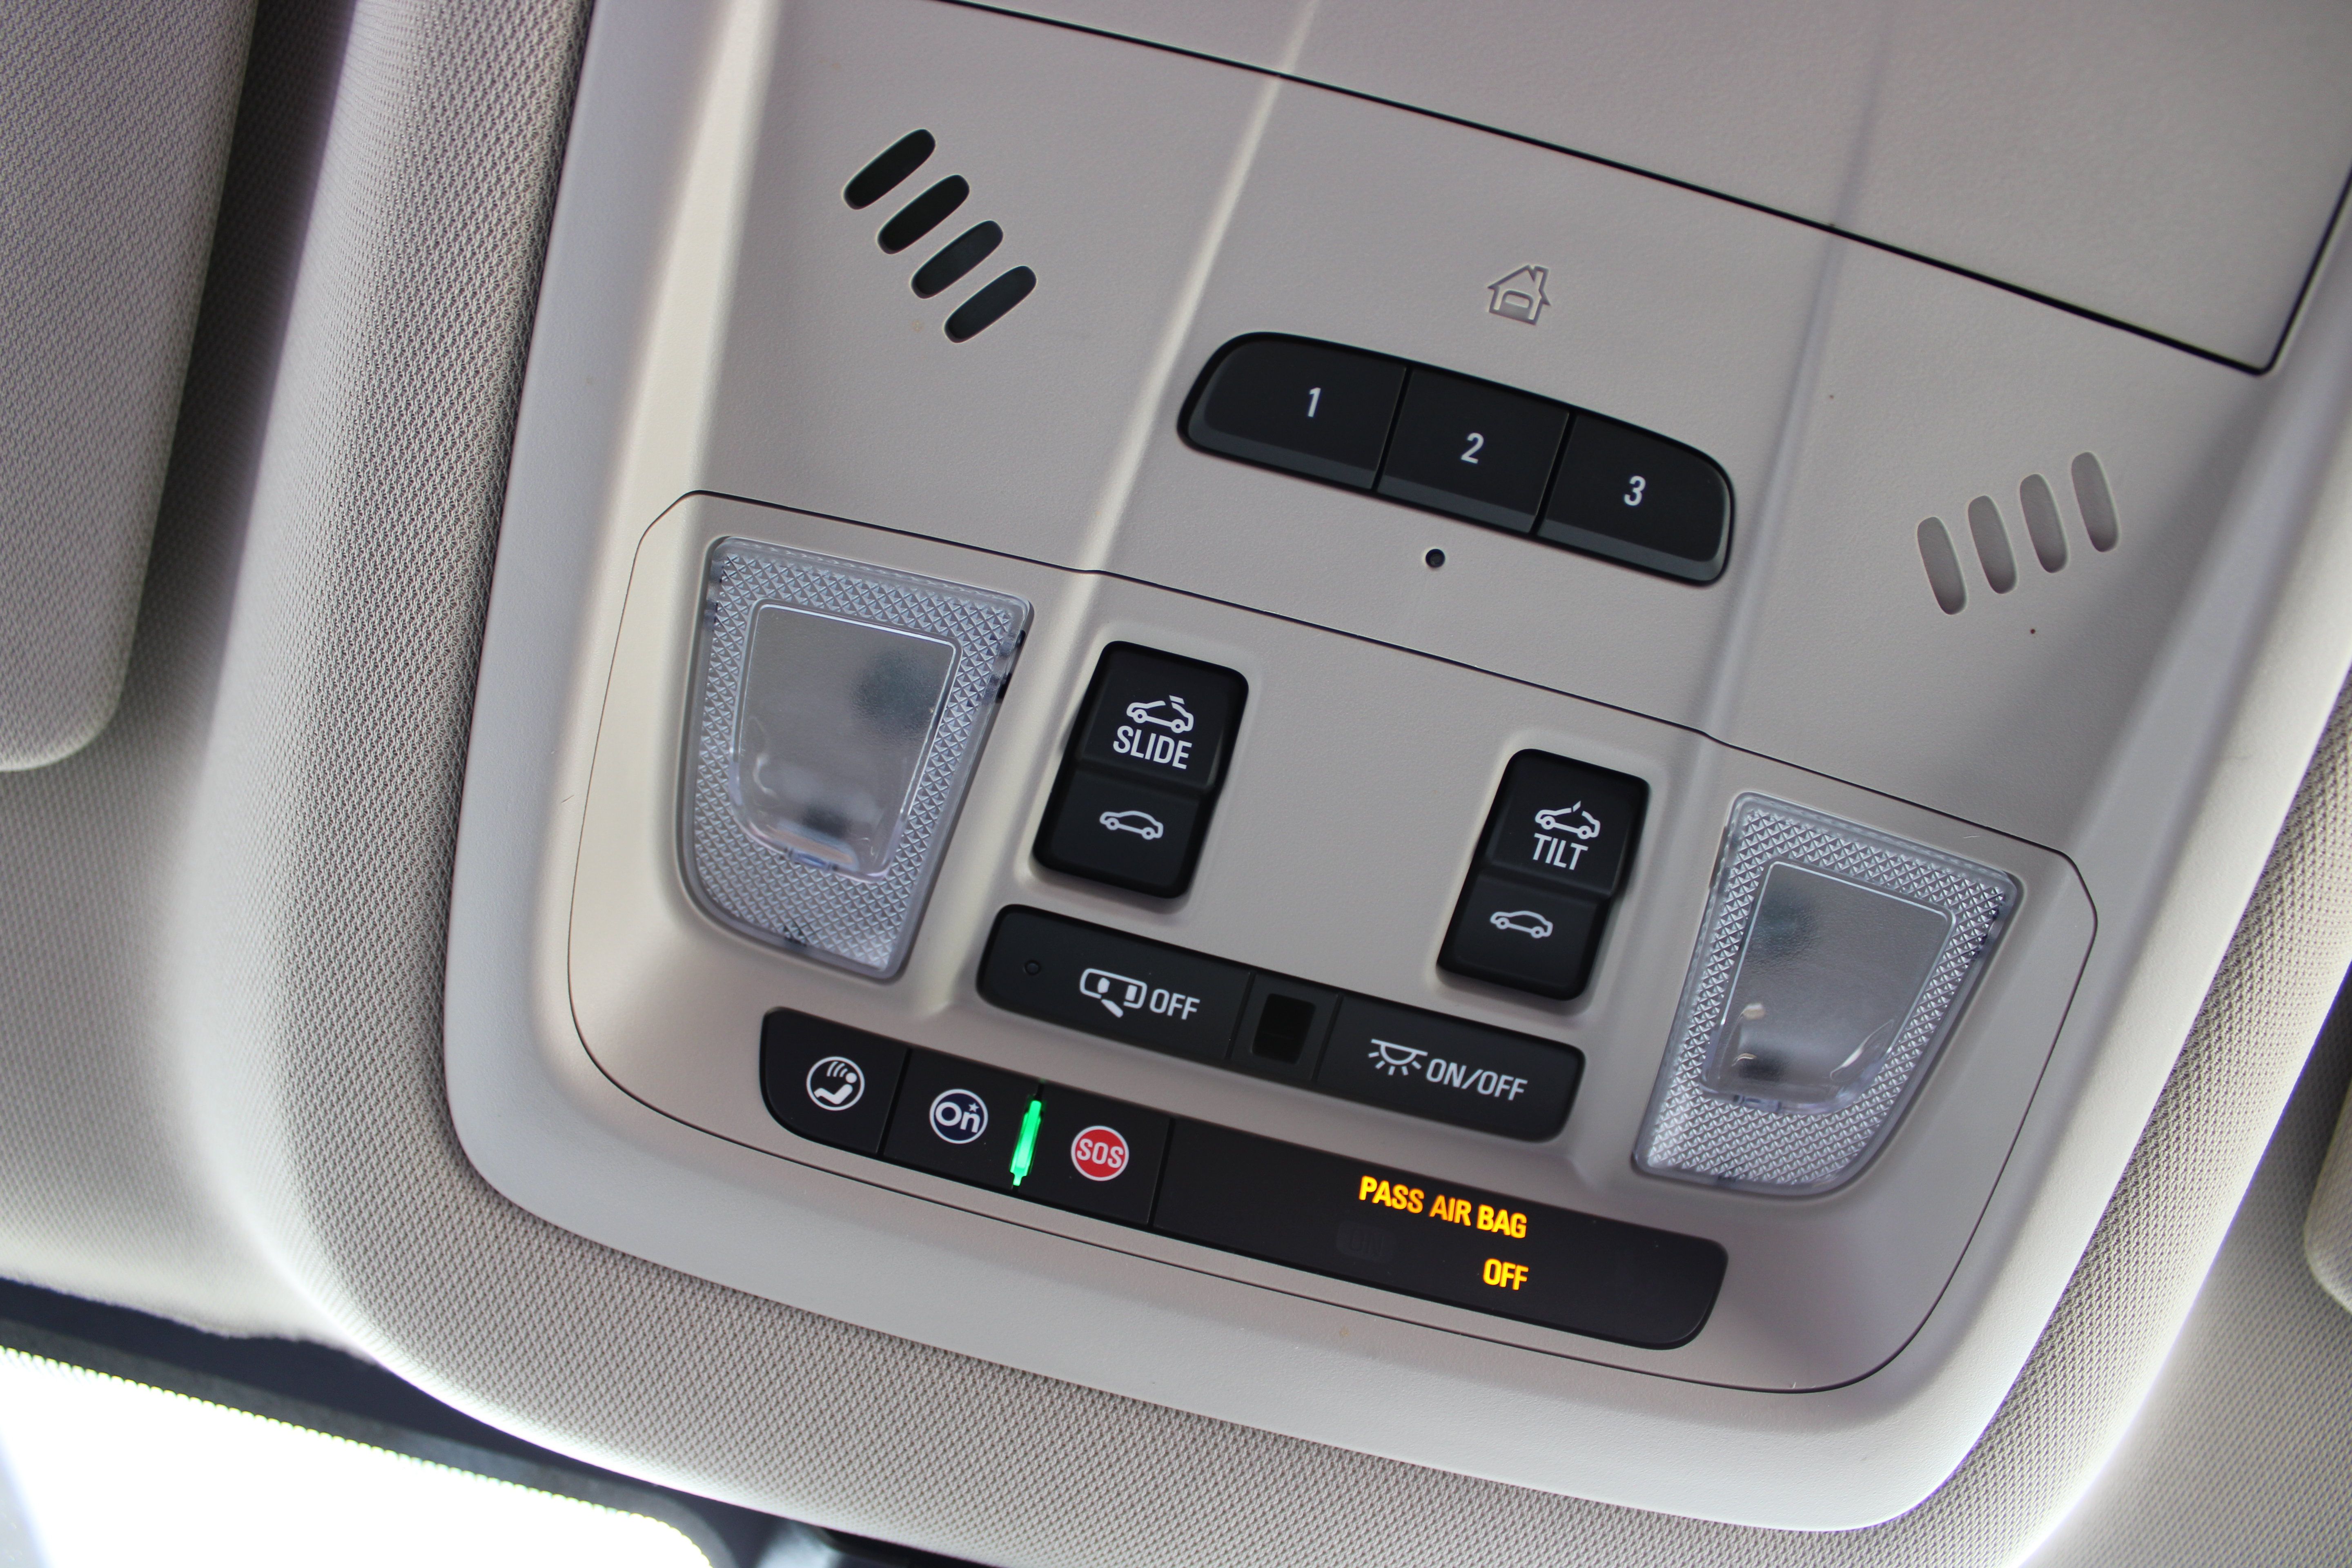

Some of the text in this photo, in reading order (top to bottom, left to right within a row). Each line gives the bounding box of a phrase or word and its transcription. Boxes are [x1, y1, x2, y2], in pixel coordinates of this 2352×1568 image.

[1307, 387, 1321, 418] 1
[1461, 432, 1485, 464] 2
[1623, 474, 1646, 506] 3
[1112, 724, 1193, 770] SLIDE
[1532, 832, 1589, 871] TILT
[1149, 988, 1200, 1020] OFF
[1425, 1058, 1528, 1101] ON/OFF
[934, 1101, 981, 1134] On
[1076, 1138, 1124, 1169] SOS
[1358, 1175, 1528, 1239] PASS AIR BAG
[1482, 1257, 1530, 1291] OFF
